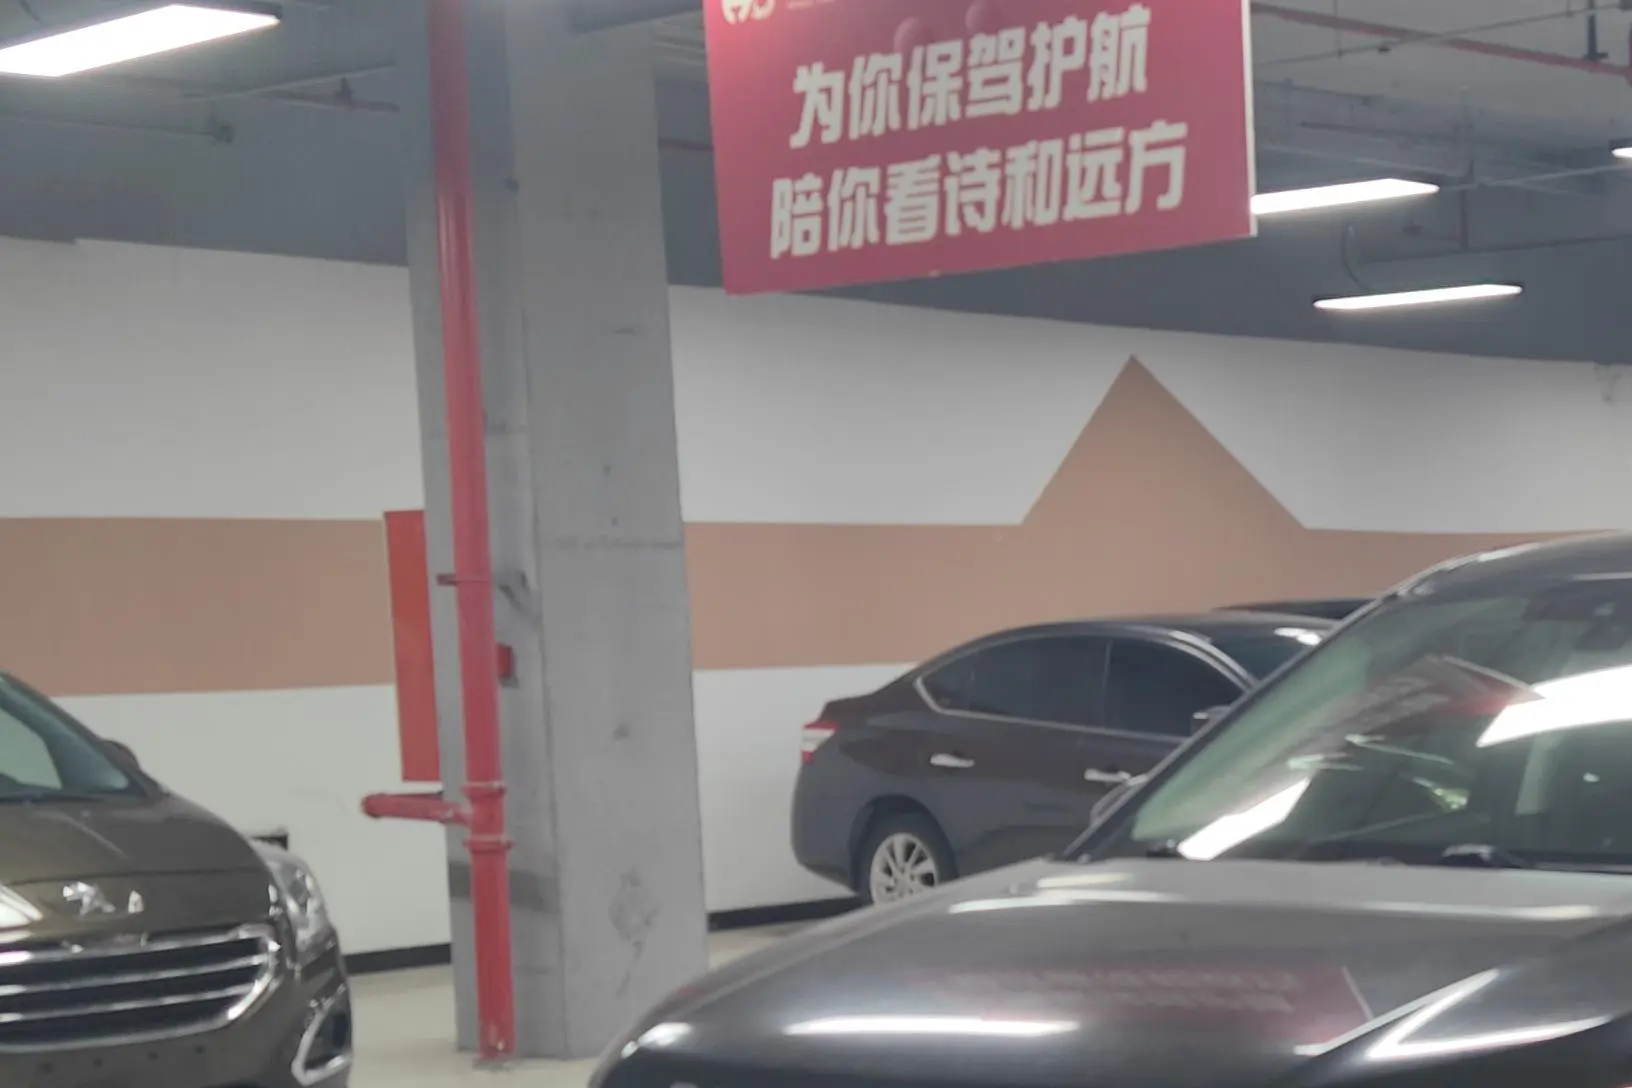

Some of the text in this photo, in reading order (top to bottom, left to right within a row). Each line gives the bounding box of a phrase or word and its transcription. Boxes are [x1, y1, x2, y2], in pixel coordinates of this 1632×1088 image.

[789, 4, 1151, 149] 为你保驾护航
[769, 120, 1188, 259] 陪你看诗和远方
